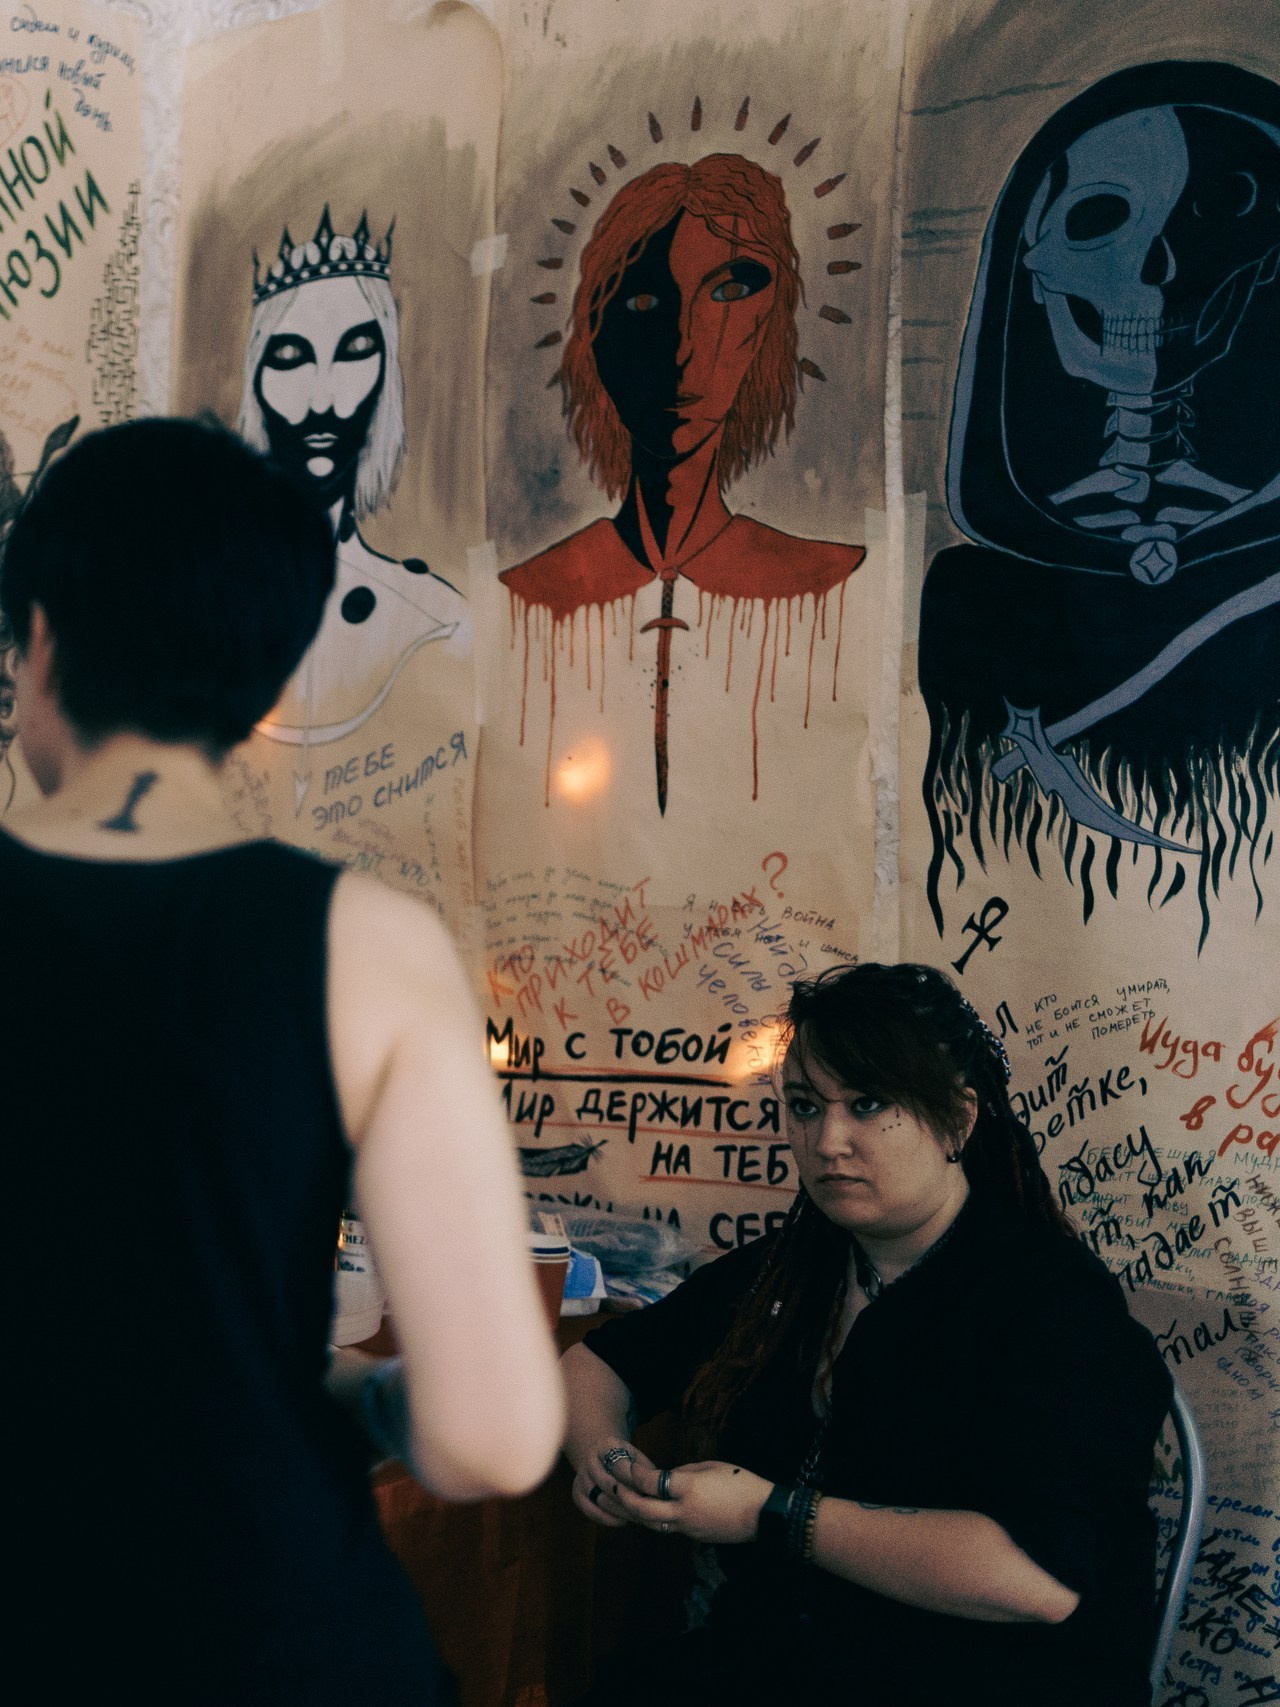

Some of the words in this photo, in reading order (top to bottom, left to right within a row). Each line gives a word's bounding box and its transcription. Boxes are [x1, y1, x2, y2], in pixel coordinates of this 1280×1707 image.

[517, 877, 651, 1018] ПРИХОДИТ
[554, 1000, 579, 1031] К
[607, 996, 632, 1025] В
[609, 1022, 733, 1065] ТОБОЙ
[576, 1087, 781, 1144] ДЕРЖИТСЯ
[649, 1141, 692, 1176] НА
[713, 1142, 792, 1185] ТЕБ
